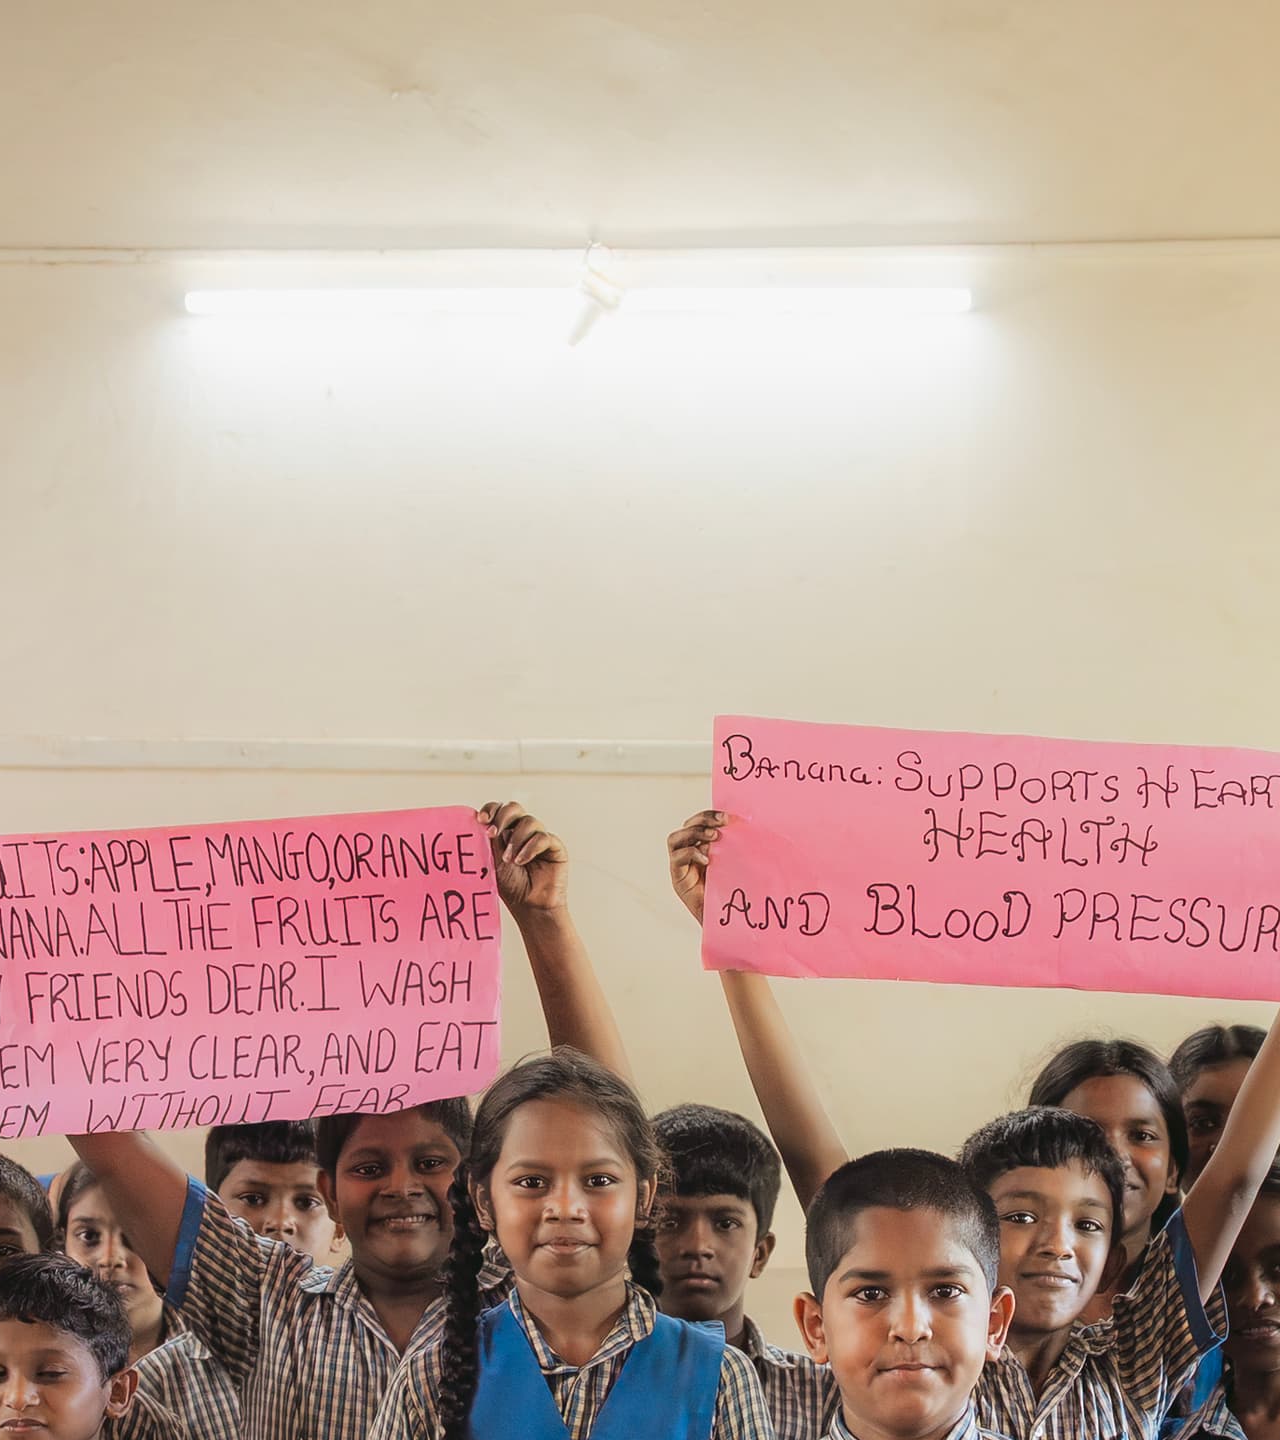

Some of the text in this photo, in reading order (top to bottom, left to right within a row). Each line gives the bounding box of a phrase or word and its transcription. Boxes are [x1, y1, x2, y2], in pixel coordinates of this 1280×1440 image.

[894, 750, 1120, 805] SUPPORTS
[923, 805, 1159, 868] HEALTH
[250, 893, 400, 949] FRUITS
[419, 889, 495, 942] ARE
[719, 887, 831, 937] AND
[863, 882, 1032, 943] BLOOD
[24, 968, 188, 1024] FRIENDS
[358, 958, 473, 1009] WASH
[76, 1035, 173, 1085] VERY
[414, 1020, 498, 1074] EAT
[85, 1089, 292, 1135] WITHOUT
